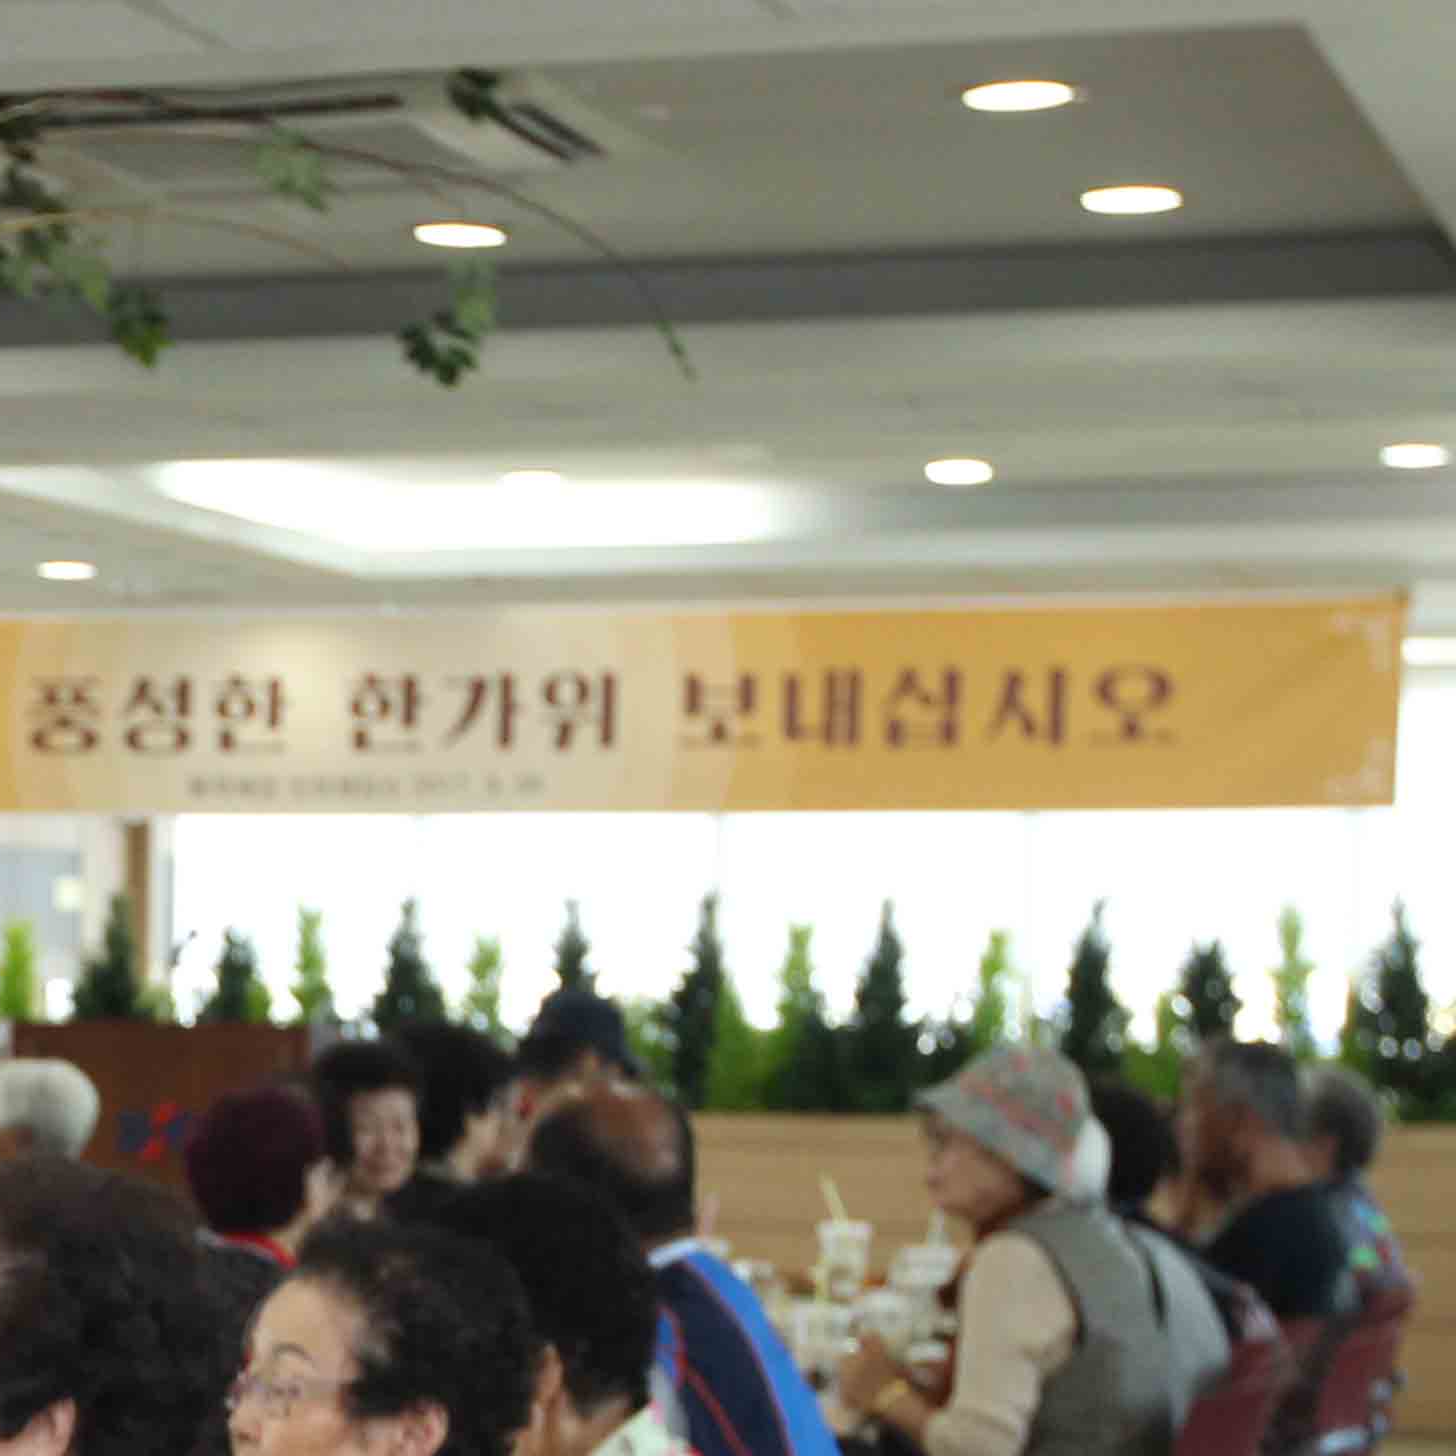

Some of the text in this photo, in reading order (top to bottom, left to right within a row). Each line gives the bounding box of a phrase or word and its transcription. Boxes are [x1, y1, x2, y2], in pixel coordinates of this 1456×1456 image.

[27, 675, 287, 754] 풍성한
[349, 673, 618, 752] 한가위
[677, 666, 1179, 750] 보내십시오
